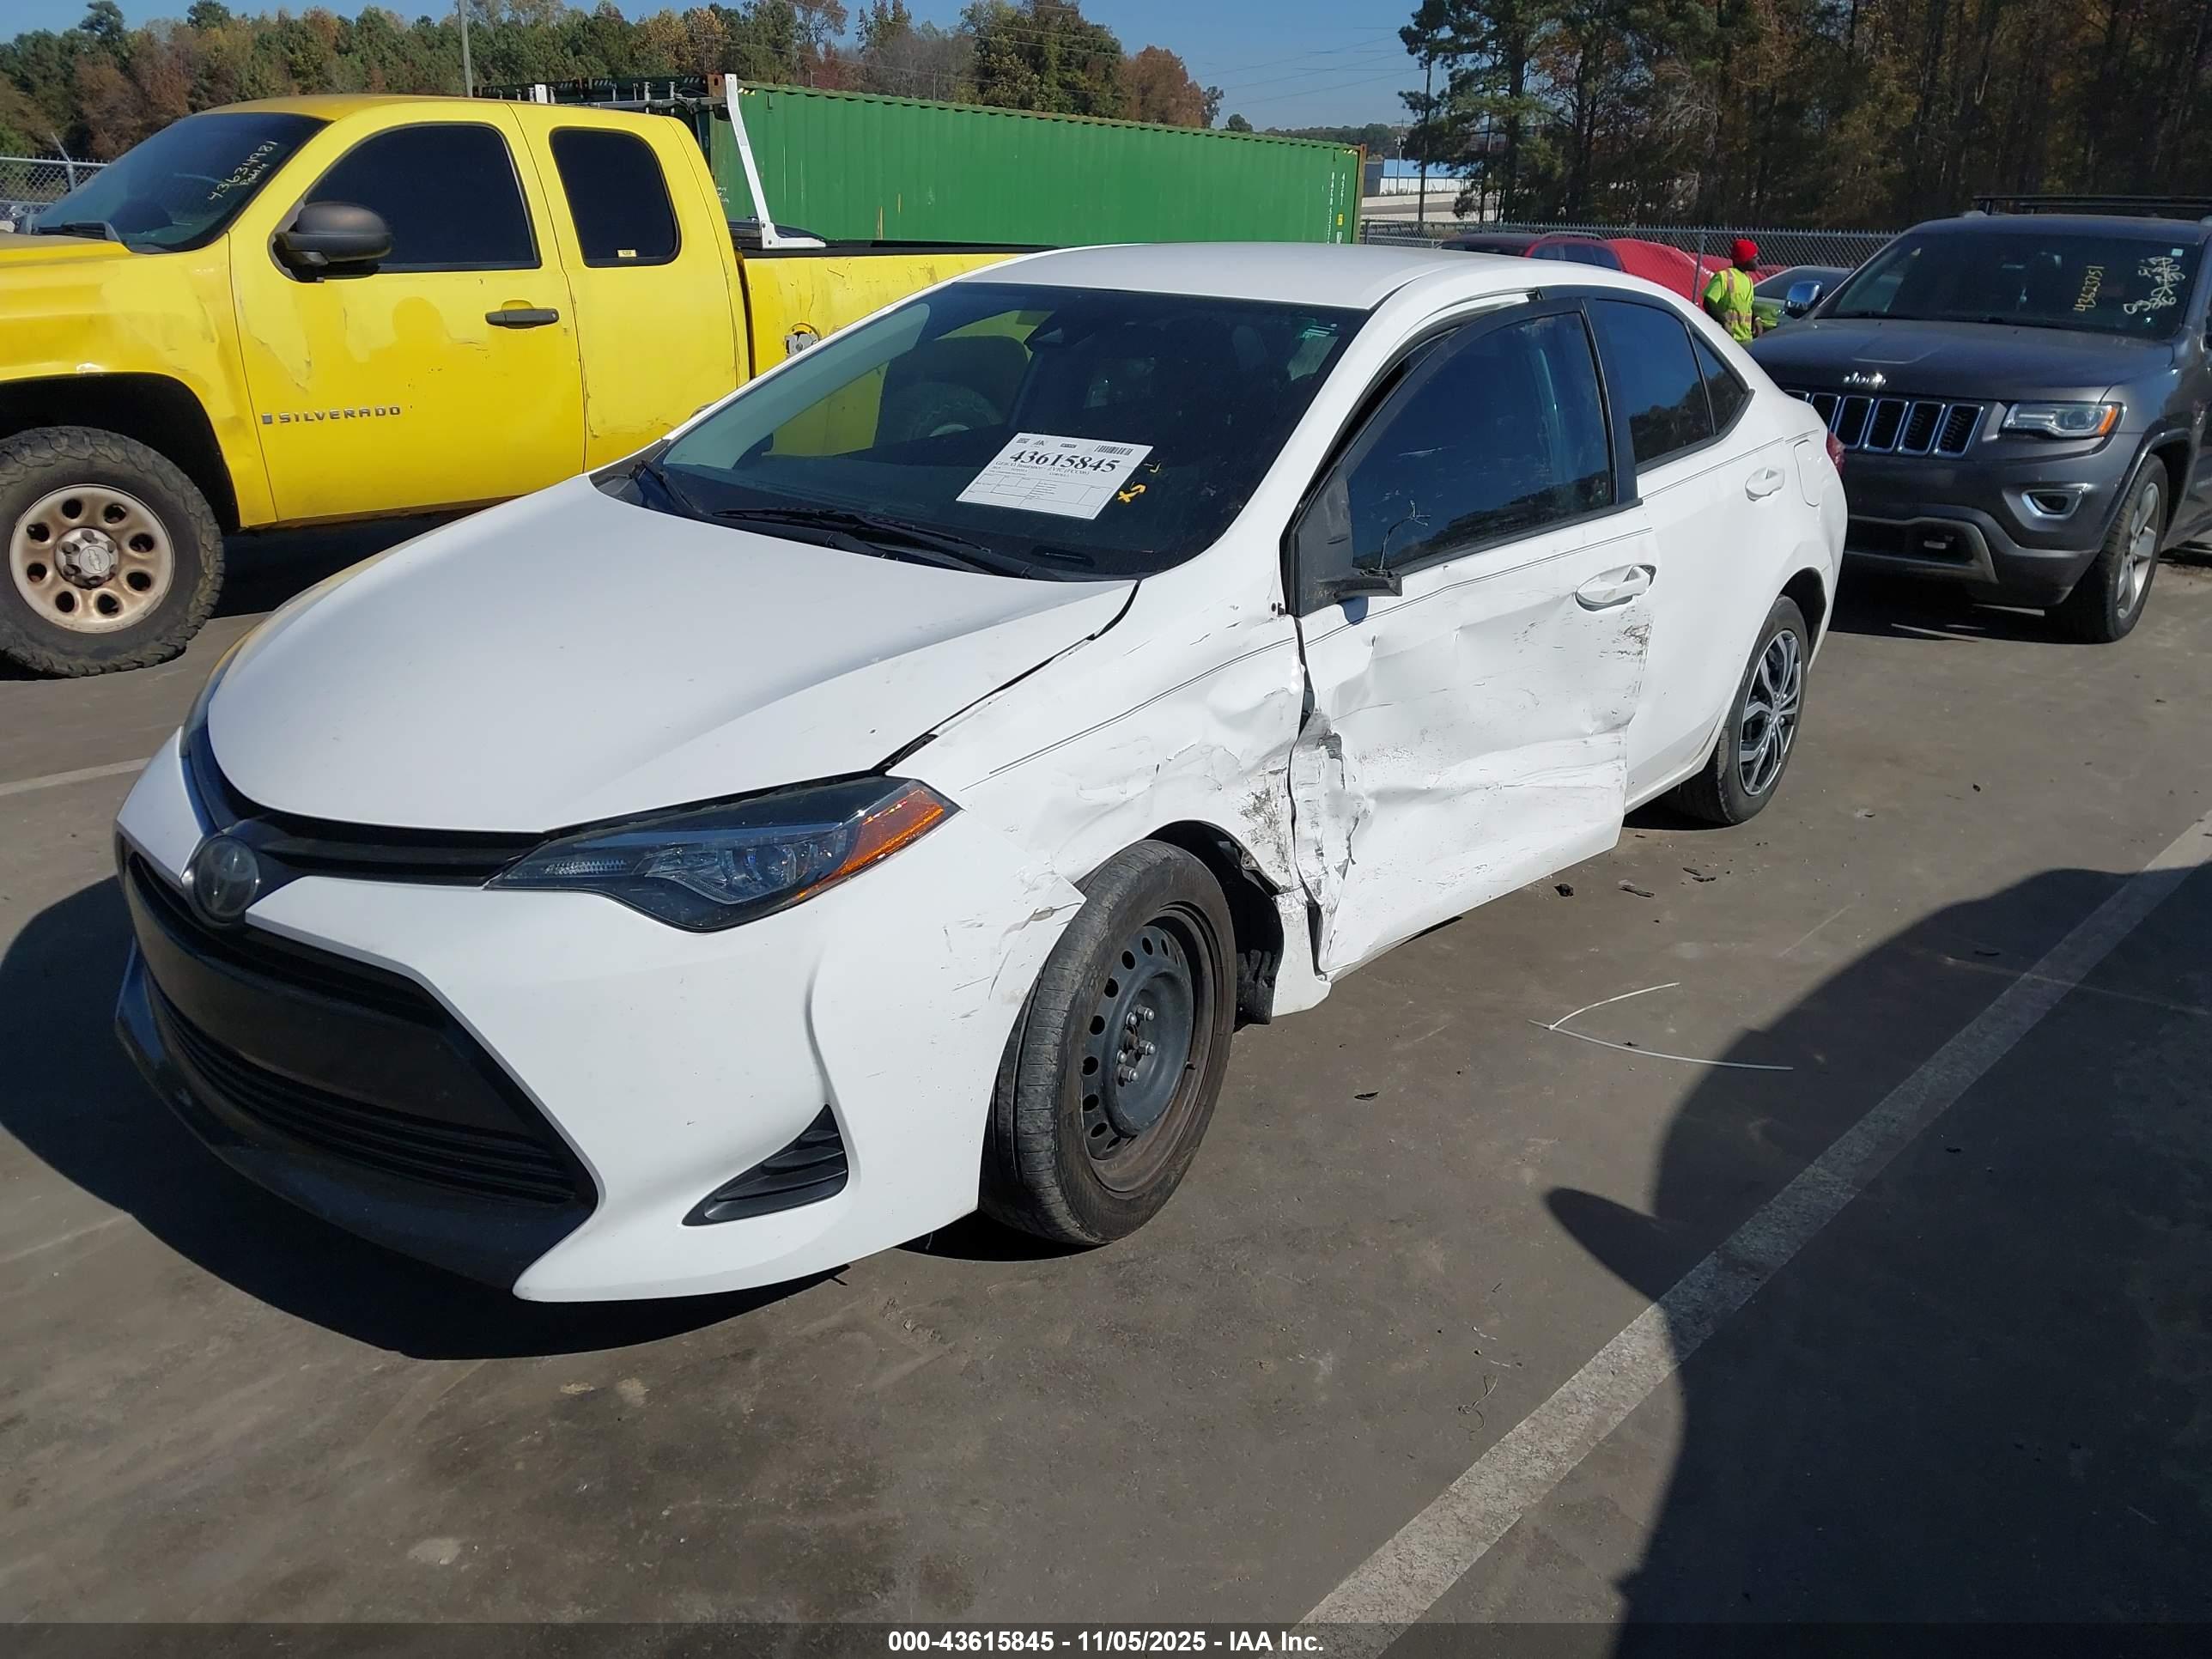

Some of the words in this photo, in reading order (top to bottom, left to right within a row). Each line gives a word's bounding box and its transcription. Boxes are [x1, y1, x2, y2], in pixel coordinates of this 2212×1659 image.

[207, 140, 278, 200] 43634981
[279, 406, 400, 423] SILVERADO
[1010, 450, 1120, 472] 43615845
